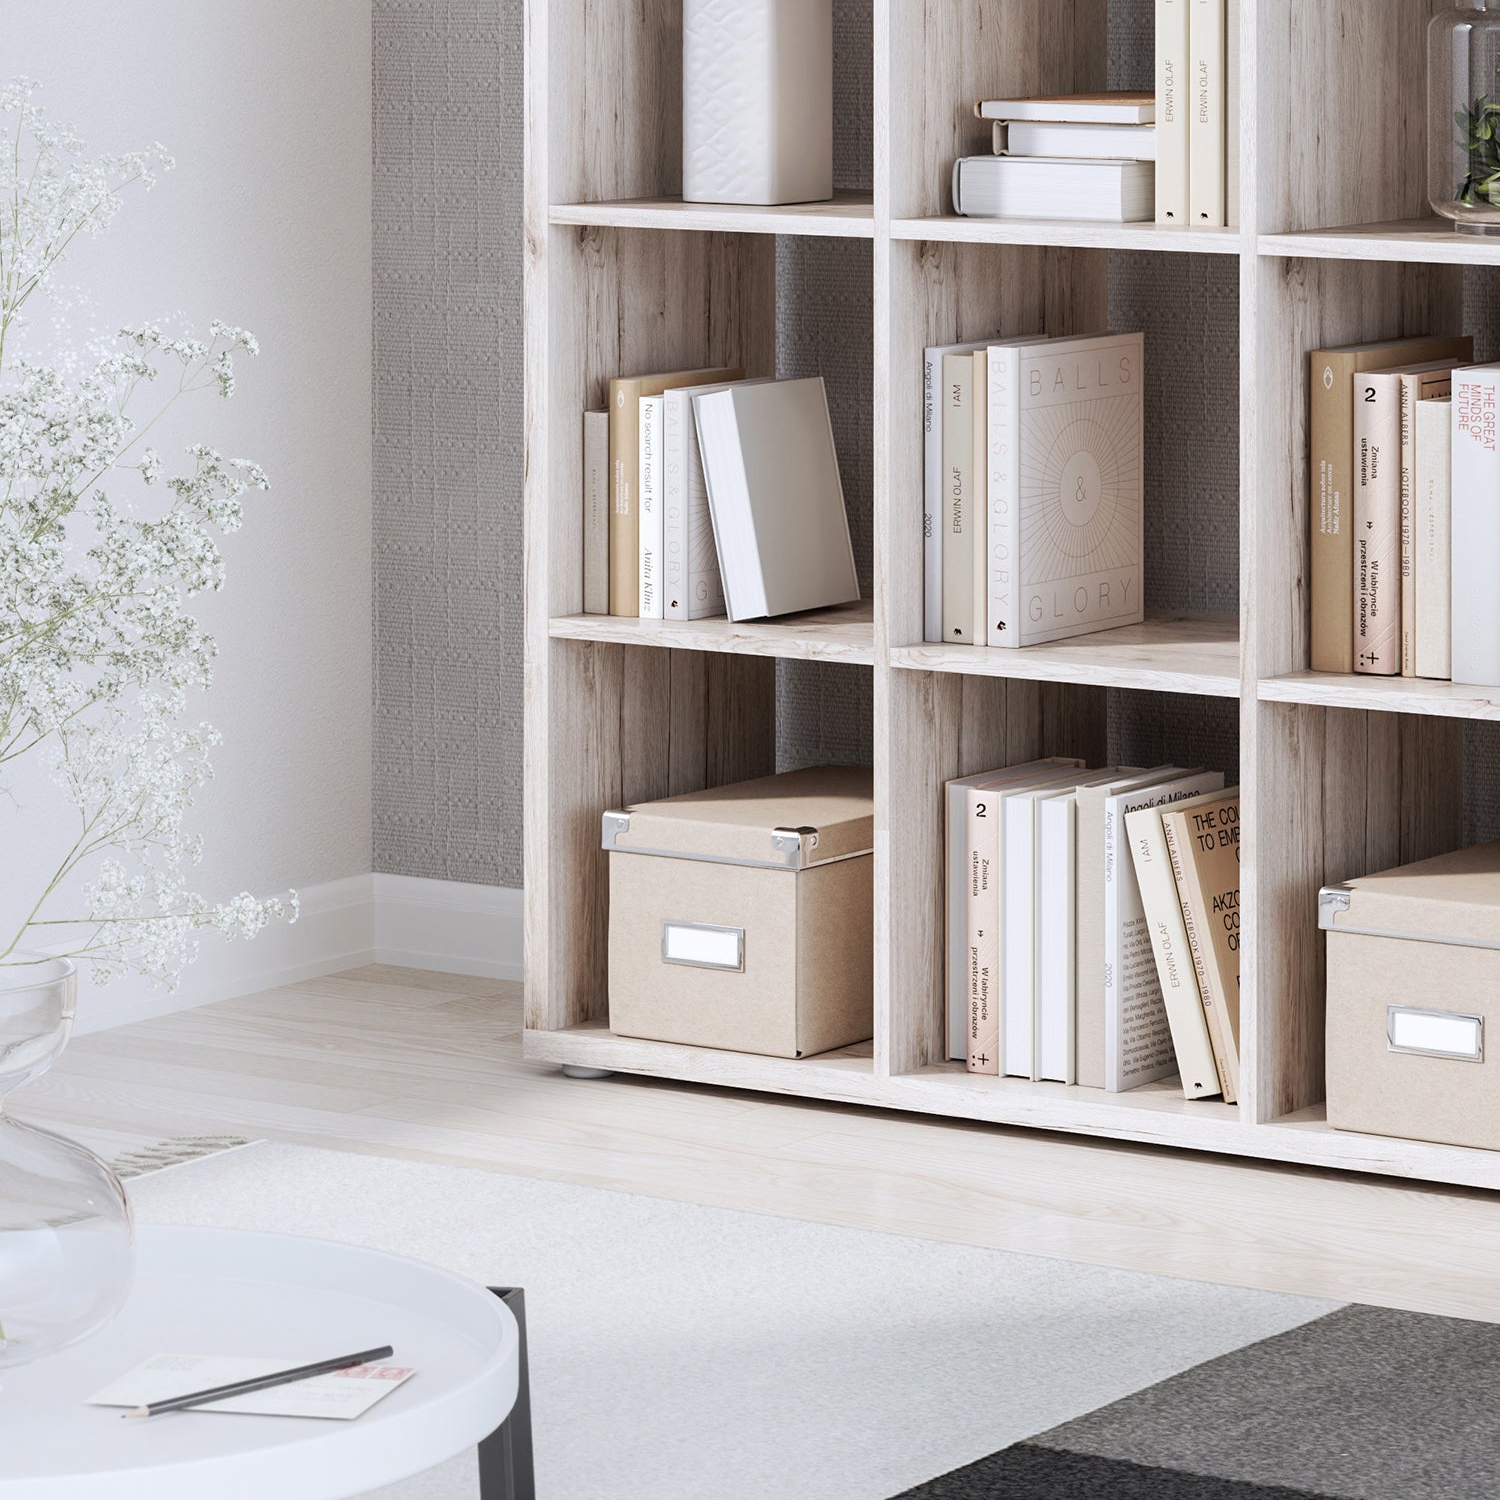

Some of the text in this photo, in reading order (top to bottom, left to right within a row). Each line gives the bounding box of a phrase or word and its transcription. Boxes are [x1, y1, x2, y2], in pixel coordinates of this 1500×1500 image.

[1165, 59, 1174, 123] ERWIN OLAF
[1199, 59, 1208, 123] ERWIN OLAF
[925, 361, 933, 432] Angoli di Milano
[953, 384, 961, 402] AM
[1029, 356, 1131, 397] BALLS
[1364, 387, 1376, 403] 2
[1401, 383, 1409, 446] ANNI ALBERS
[1458, 383, 1469, 431] FUTURE
[1470, 384, 1482, 442] MINDS OF
[1483, 385, 1496, 452] THE GREAT
[643, 403, 653, 513] No search result for
[1360, 437, 1369, 487] ustawienia
[1371, 445, 1380, 480] Zmiana
[953, 466, 962, 534] ERWIN OLAF
[1075, 475, 1087, 502] &
[1401, 467, 1410, 522] NOTEBOOK
[923, 512, 933, 538] 2020
[644, 547, 653, 579] Anita
[992, 499, 1009, 606] GLORY
[1359, 539, 1369, 591] przestrzeni
[1028, 577, 1132, 622] GLORY
[1369, 560, 1379, 618] W labiryncie
[1360, 597, 1369, 637] obrazów
[976, 803, 987, 818] 2
[1192, 811, 1217, 832] THE
[1105, 811, 1114, 883] Angoli di Milano
[1139, 839, 1151, 856] AM
[1164, 822, 1184, 882] ANNI ALBERS
[1196, 833, 1215, 852] TO
[972, 850, 980, 897] ustawienia
[982, 858, 990, 891] Zmiana
[1182, 900, 1200, 954] NOTEBOOK
[970, 946, 979, 996] przestrzeni
[1104, 963, 1113, 988] 2020
[1157, 921, 1180, 989] ERWIN OLAF
[980, 967, 989, 1021] W labiryncie
